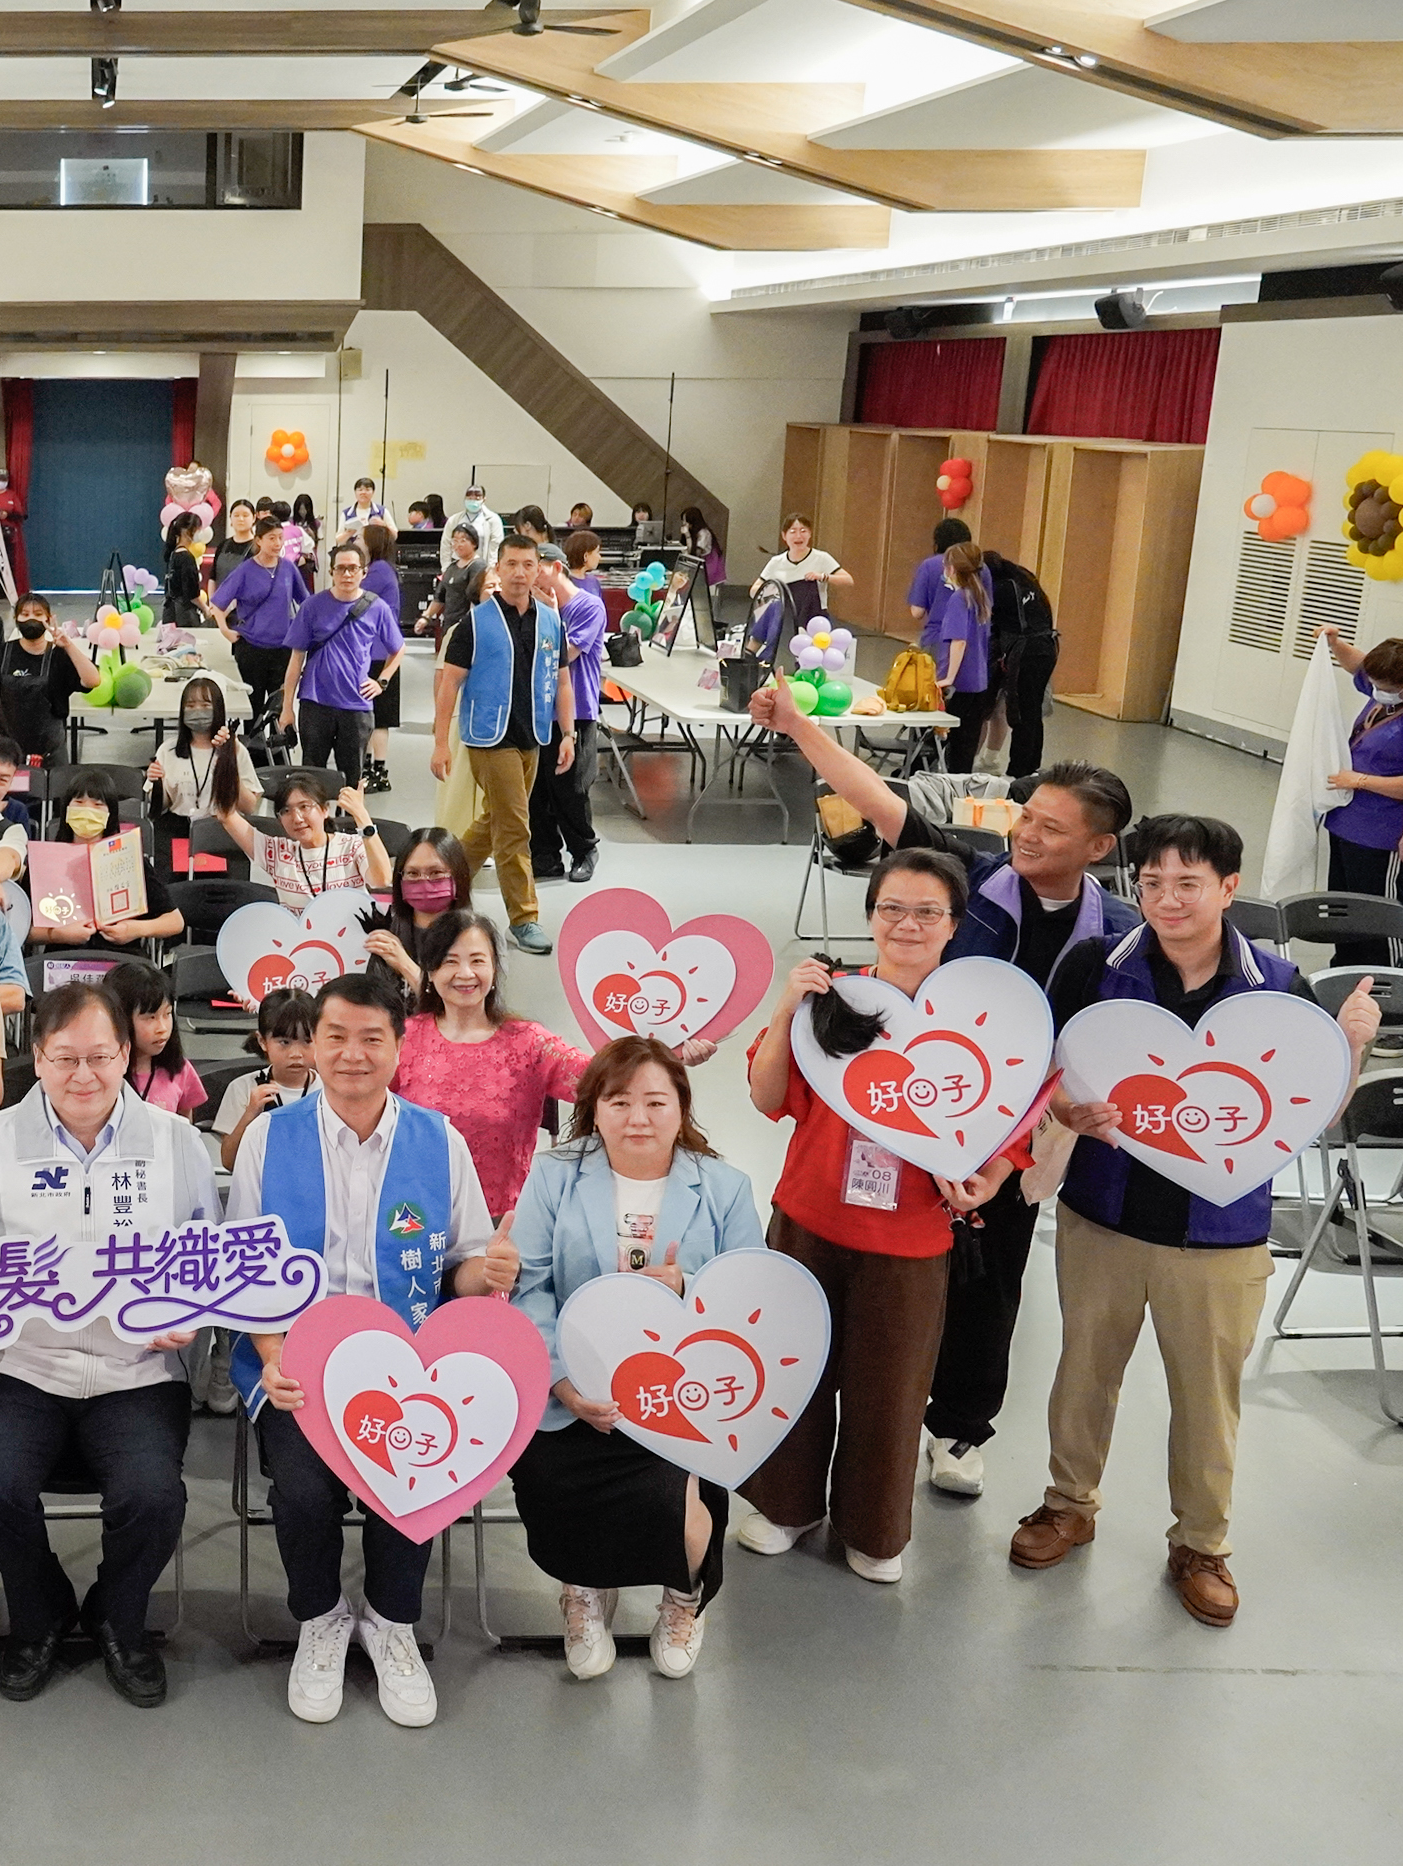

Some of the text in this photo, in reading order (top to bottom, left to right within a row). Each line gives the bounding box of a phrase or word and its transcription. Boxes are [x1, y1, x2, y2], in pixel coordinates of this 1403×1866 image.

[872, 1169, 892, 1182] 08
[90, 1221, 305, 1320] 共織愛
